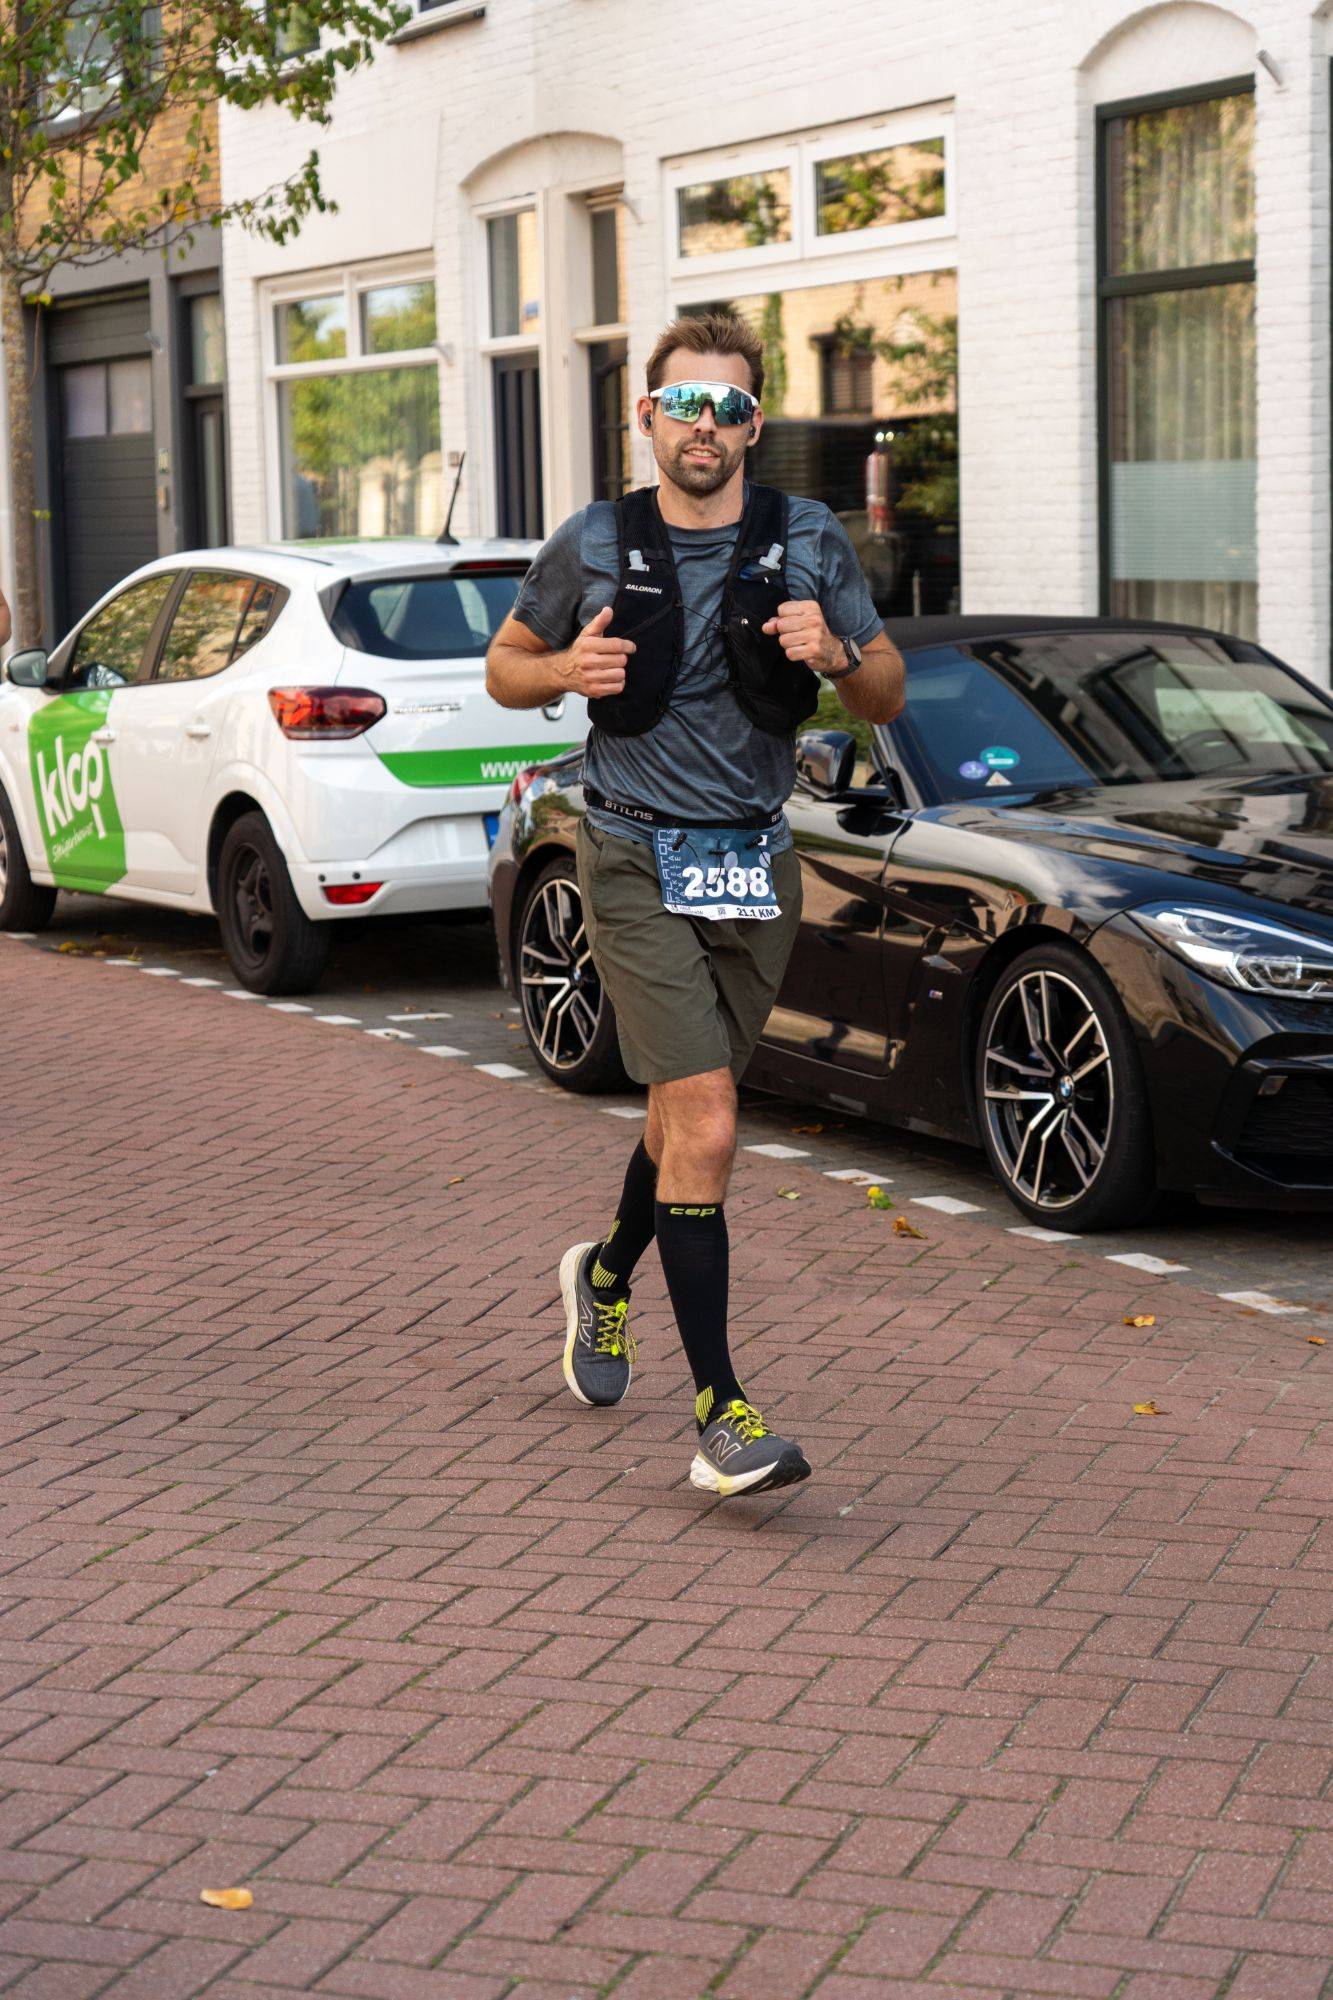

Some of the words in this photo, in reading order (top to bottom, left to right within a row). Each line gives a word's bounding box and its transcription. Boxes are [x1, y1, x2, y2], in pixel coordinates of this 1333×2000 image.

[625, 584, 662, 594] SALOMON
[604, 799, 654, 822] BTTLNS
[657, 829, 675, 903] FLATON
[667, 829, 680, 904] MAKELAARS
[682, 867, 769, 897] 2588
[736, 908, 756, 917] 21.1
[759, 908, 776, 918] KM
